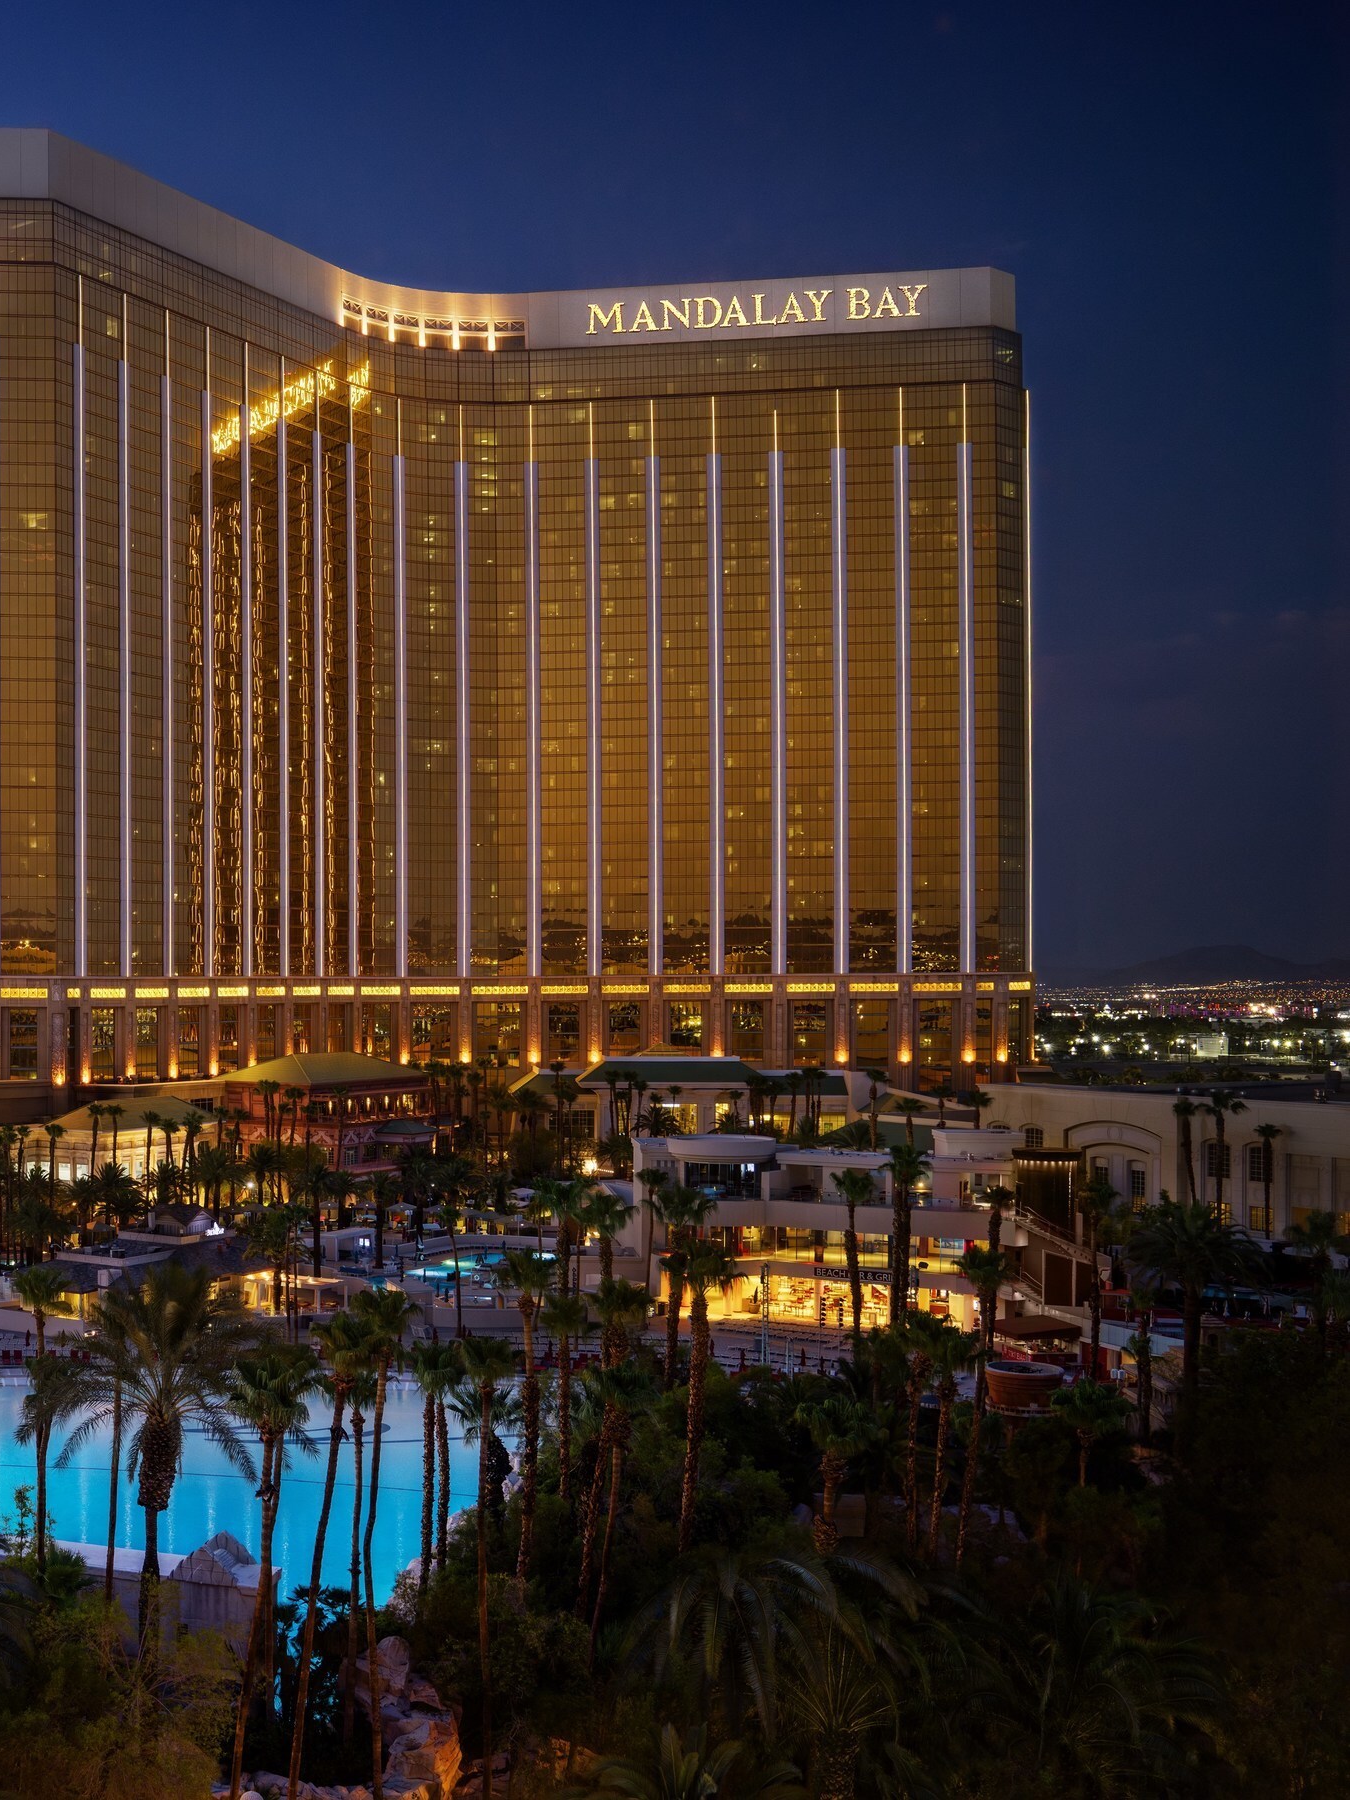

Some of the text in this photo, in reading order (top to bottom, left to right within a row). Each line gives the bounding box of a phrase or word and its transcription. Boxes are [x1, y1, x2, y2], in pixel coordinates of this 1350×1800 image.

[585, 284, 928, 335] MANDALAY BAY
[816, 1268, 846, 1278] BEACH
[866, 1272, 874, 1281] &
